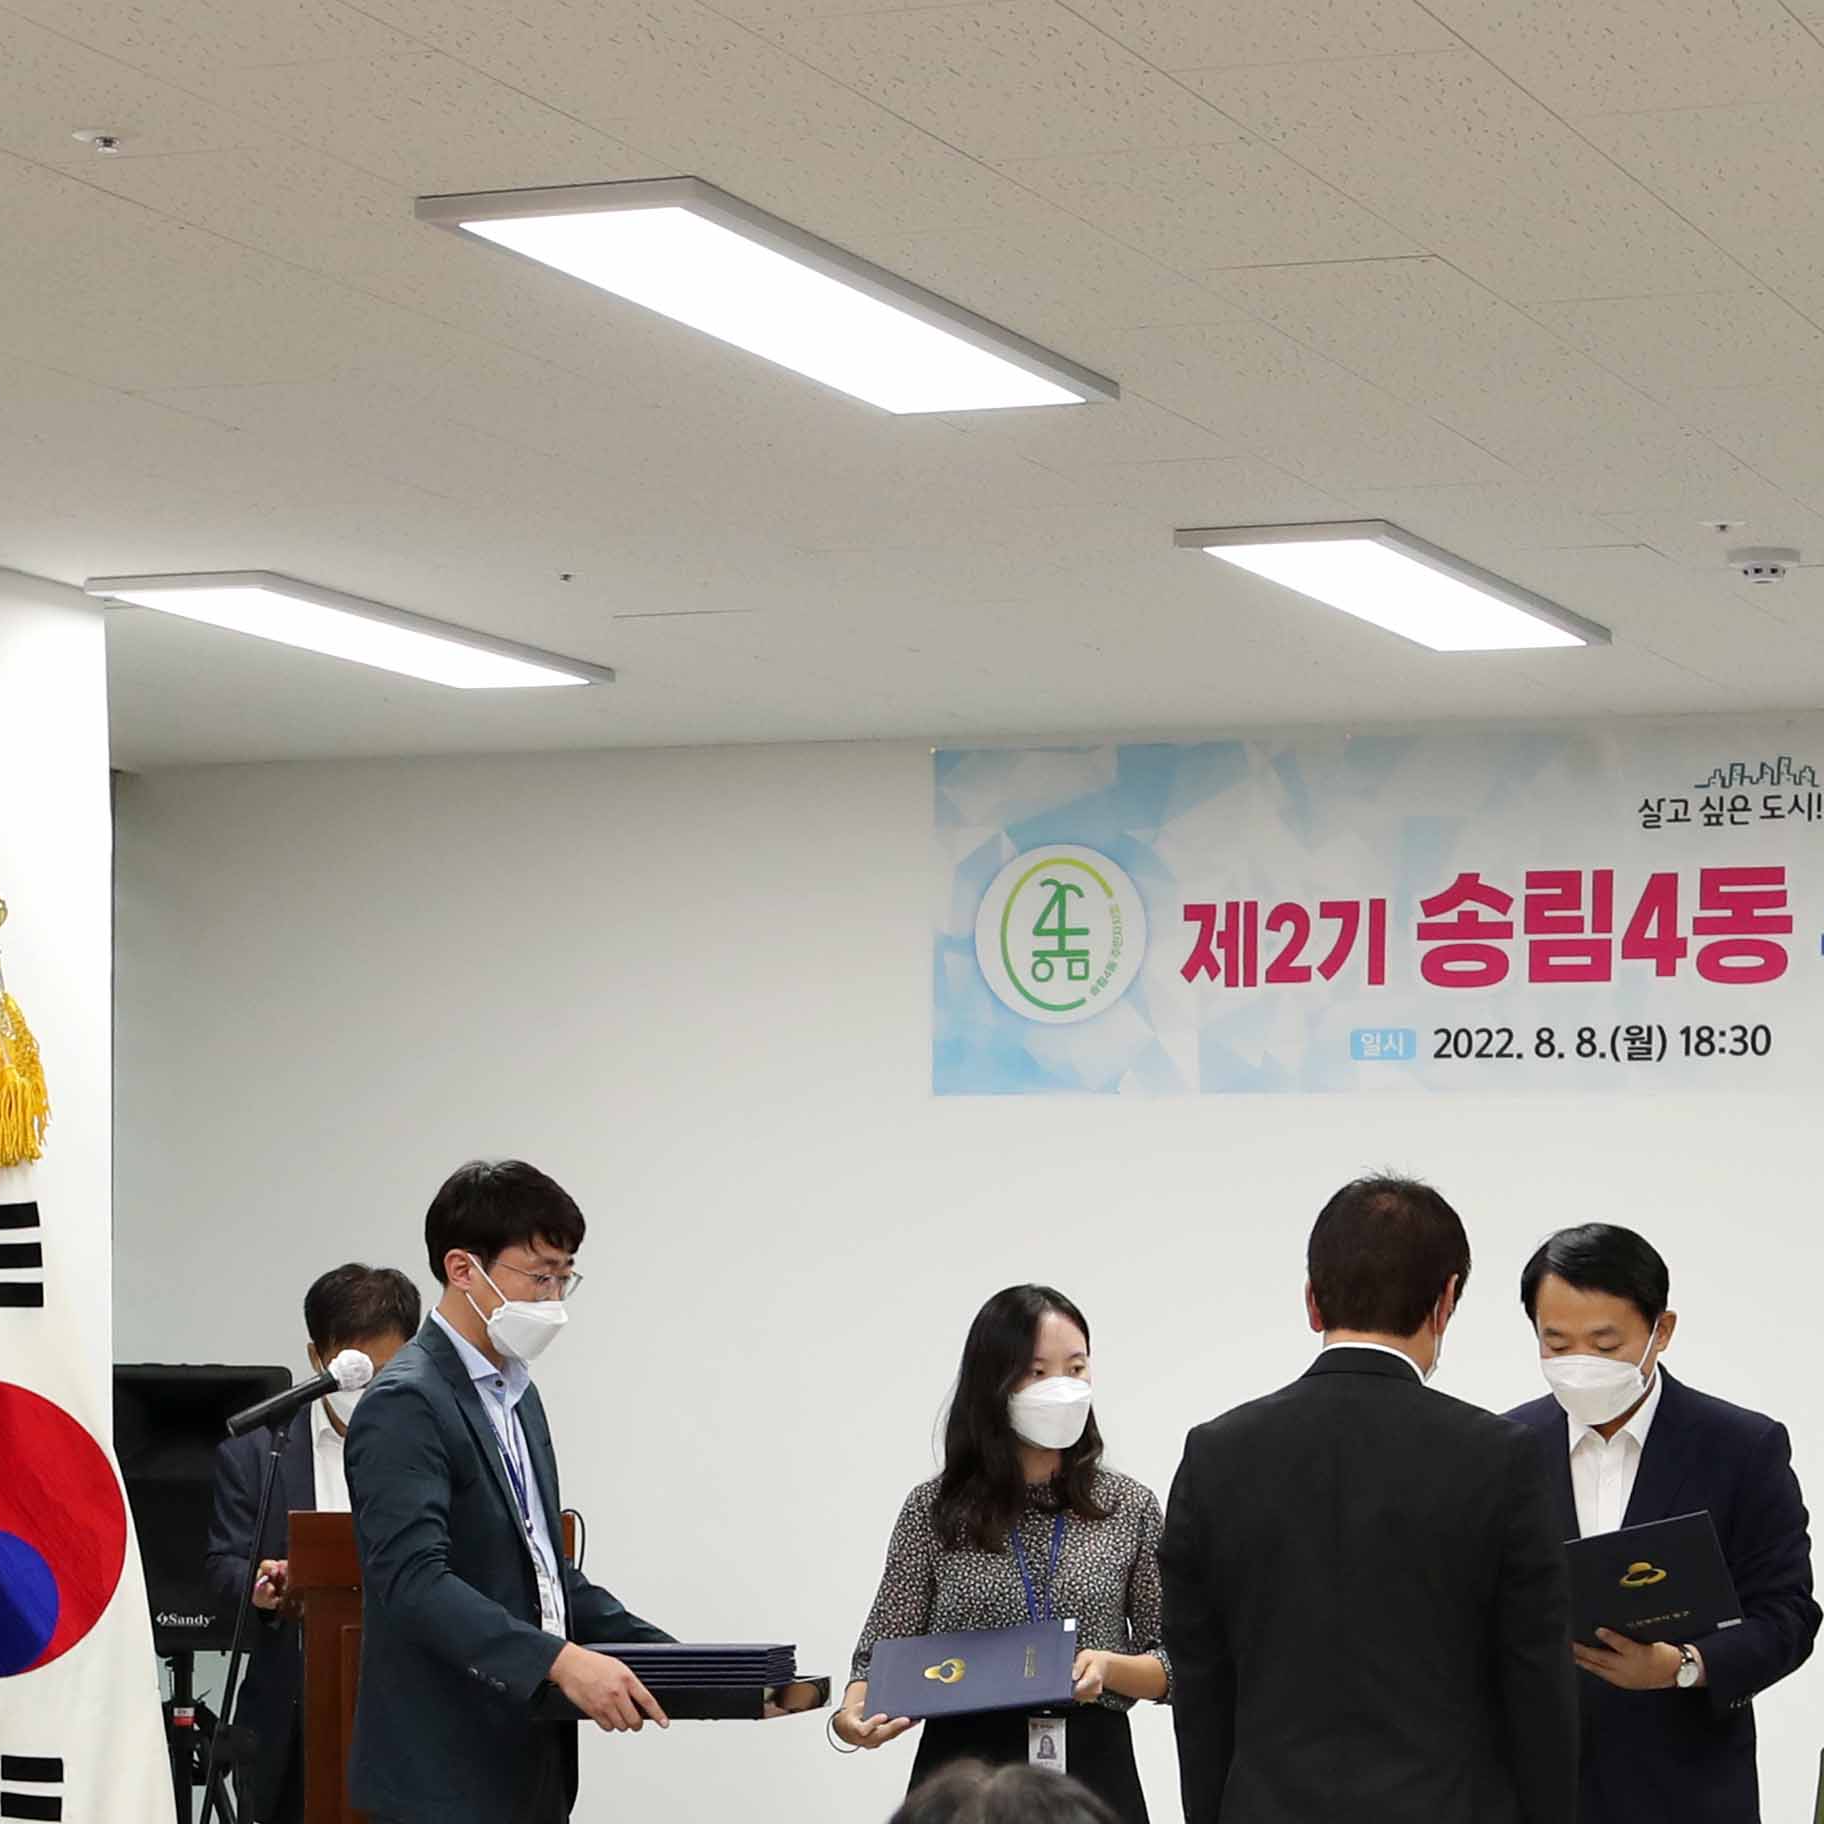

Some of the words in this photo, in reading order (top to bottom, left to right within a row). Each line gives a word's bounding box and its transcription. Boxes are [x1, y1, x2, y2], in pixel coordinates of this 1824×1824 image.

[1637, 797, 1692, 830] 살고
[1698, 794, 1753, 827] 싶은
[1759, 791, 1823, 823] 도시!
[1179, 898, 1387, 988] 제2기
[1416, 865, 1794, 989] 송림4동
[1360, 1032, 1405, 1056] 일시
[1433, 1027, 1524, 1060] 2022.
[1534, 1026, 1565, 1060] 8.
[1575, 1024, 1668, 1063] 8.(월)
[1679, 1024, 1772, 1057] 18:30
[168, 1612, 210, 1628] Sandy
